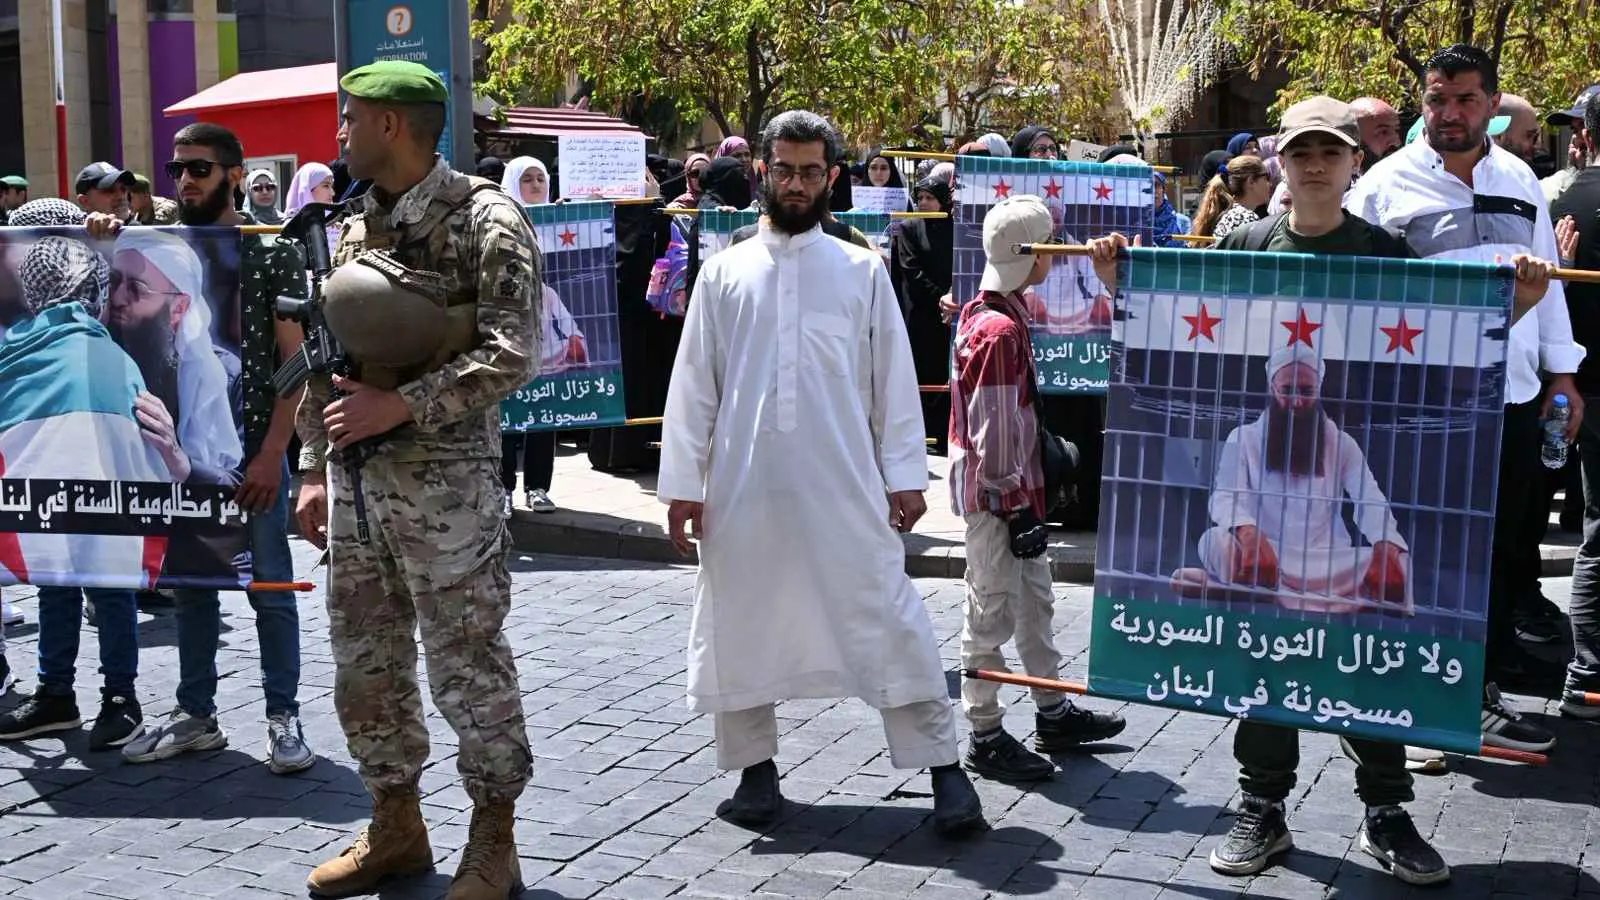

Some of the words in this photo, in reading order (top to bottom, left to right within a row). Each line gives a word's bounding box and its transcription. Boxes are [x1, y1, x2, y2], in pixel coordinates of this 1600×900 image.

[561, 380, 590, 400] تزال
[594, 377, 616, 396] ولا
[1038, 371, 1046, 386] ف
[1053, 371, 1109, 391] سجونة
[515, 411, 535, 432] في
[541, 409, 598, 426] مسجونة
[0, 478, 31, 521] لبنا
[38, 480, 68, 529] في
[74, 480, 122, 514] السنة
[128, 480, 212, 525] مظلومية
[1110, 603, 1224, 646] السورية
[1237, 619, 1326, 662] الثورة
[1337, 633, 1407, 675] تزال
[1418, 642, 1464, 684] ولا
[1146, 664, 1215, 706] لبنان
[1223, 677, 1269, 719] في
[1282, 679, 1413, 728] مسجونة
